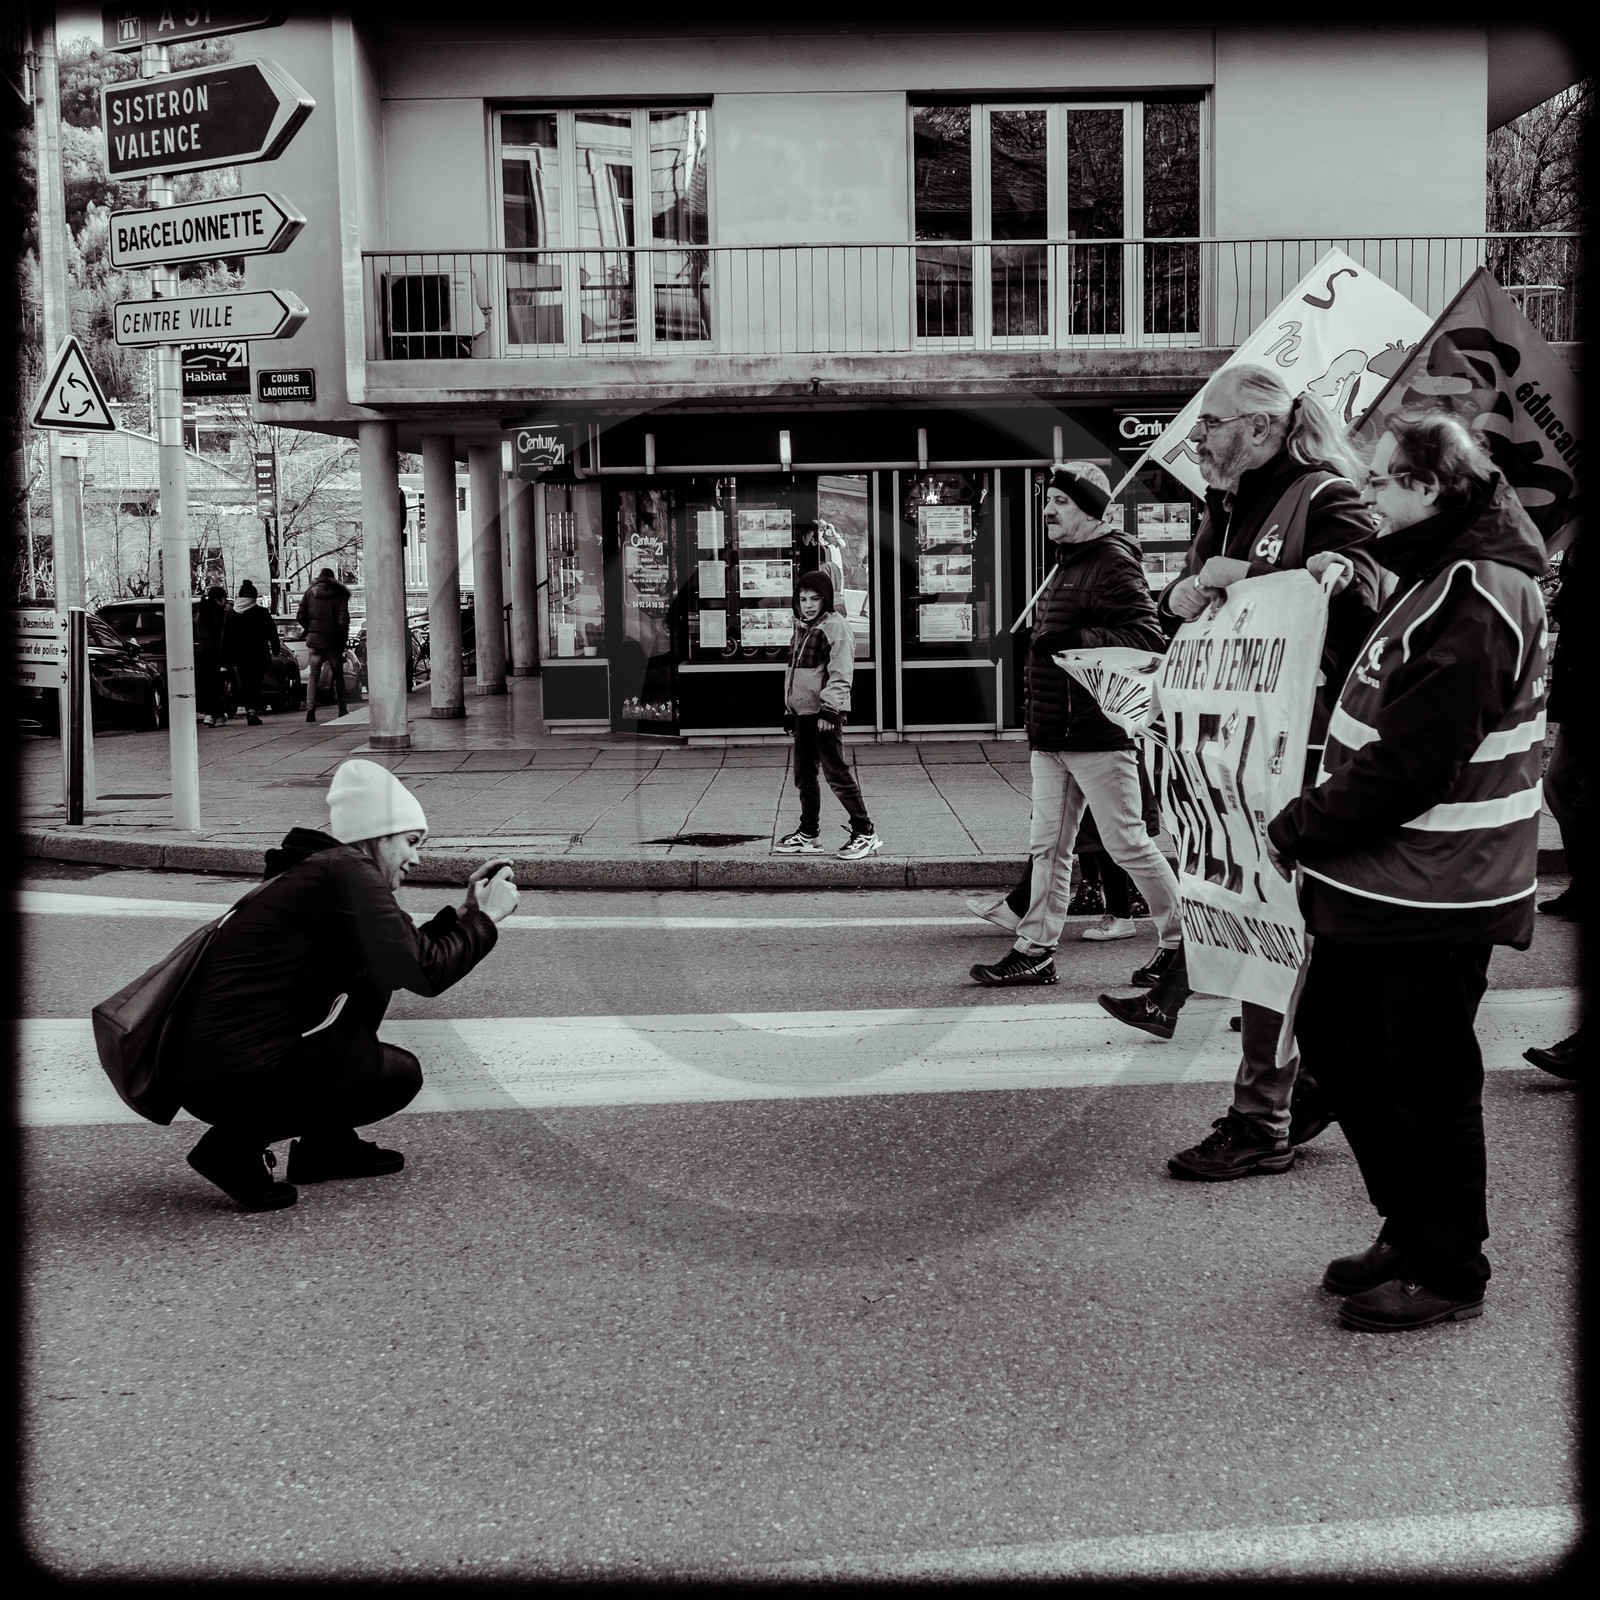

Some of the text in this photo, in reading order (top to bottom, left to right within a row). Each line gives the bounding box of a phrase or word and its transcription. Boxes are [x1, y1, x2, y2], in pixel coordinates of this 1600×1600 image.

[158, 3, 175, 31] A
[112, 84, 209, 126] SISTERON
[115, 123, 202, 162] VALENCE
[118, 208, 264, 253] BARCELONNETTE
[122, 305, 233, 334] CENTRE VILLE
[226, 342, 248, 368] 21
[185, 371, 227, 382] Habitat
[271, 373, 300, 383] COURS
[262, 385, 310, 397] LADOUCETTE
[1117, 416, 1168, 438] Centu
[517, 431, 565, 465] Century 21
[631, 533, 664, 556] Century 21
[23, 618, 54, 629] Desmichels
[34, 643, 41, 654] de
[42, 643, 59, 657] police
[1161, 630, 1214, 691] PRIVÉS
[1213, 637, 1286, 693] D'EMPLOI
[1181, 896, 1257, 957] ROTECTION
